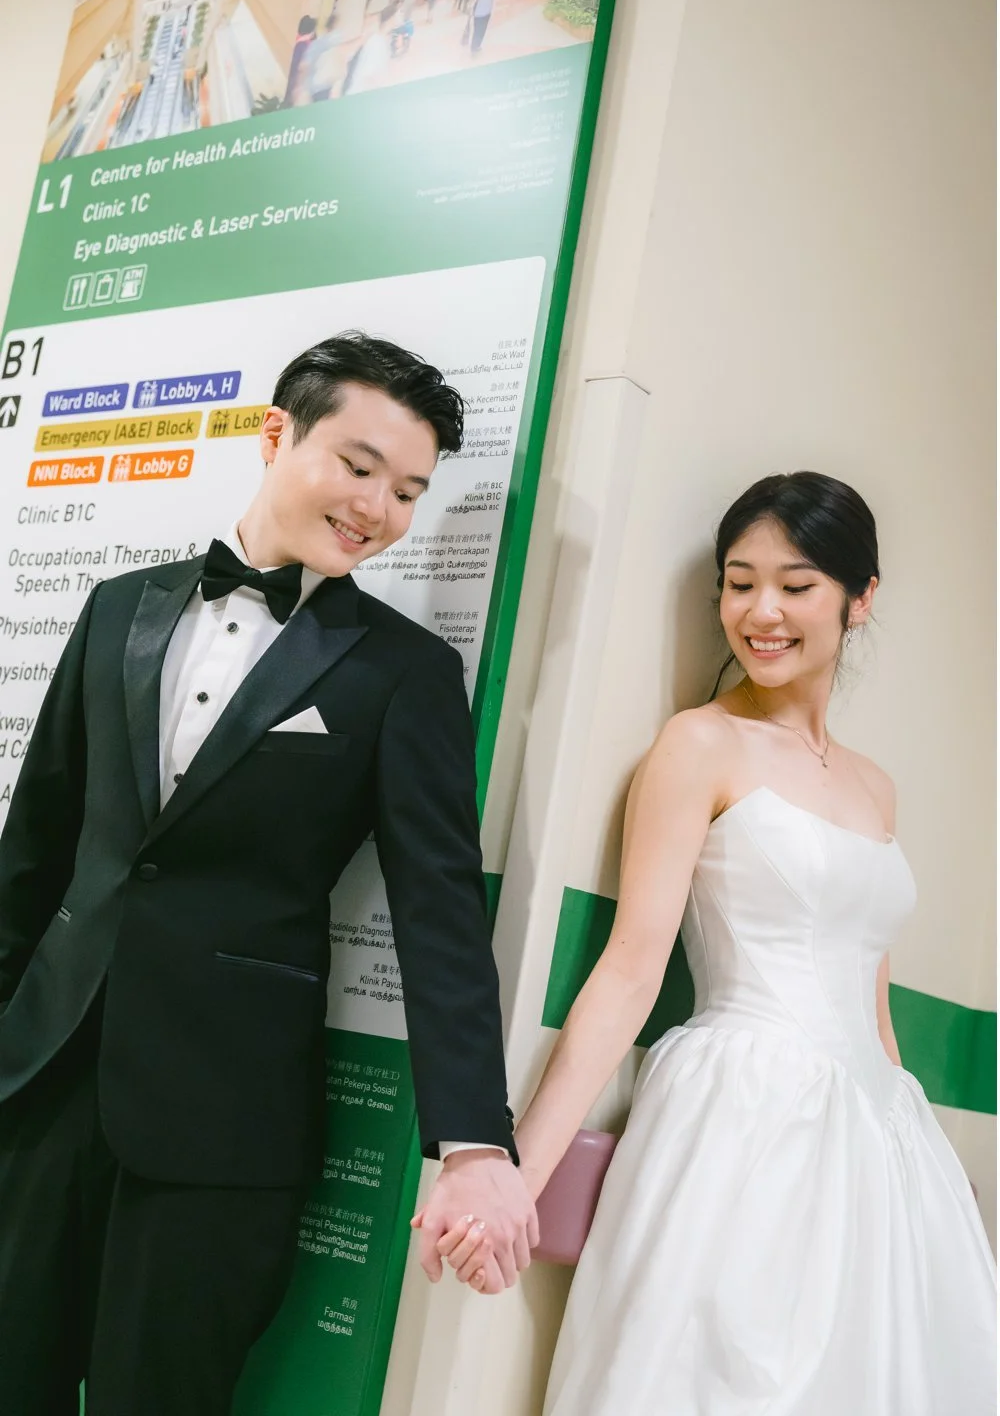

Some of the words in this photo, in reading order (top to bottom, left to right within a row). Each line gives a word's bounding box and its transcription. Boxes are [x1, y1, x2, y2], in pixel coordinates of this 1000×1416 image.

[91, 163, 142, 187] Centre
[145, 156, 170, 176] for
[171, 142, 227, 170] Health
[229, 126, 316, 158] Activation
[37, 174, 73, 214] L1
[83, 198, 126, 223] Clinic
[131, 192, 151, 215] 1C
[74, 239, 102, 262] Eye
[104, 222, 188, 255] Diagnostic
[191, 218, 205, 239] &
[208, 212, 260, 235] Laser
[261, 198, 340, 227] Services
[124, 269, 144, 281] ATM
[1, 336, 45, 380] B1
[160, 381, 202, 402] Lobby
[203, 380, 218, 398] A,
[221, 377, 235, 395] H
[50, 394, 83, 412] Ward
[84, 390, 121, 408] Block
[234, 412, 265, 430] Lob
[40, 429, 111, 449] Emergency
[114, 421, 153, 441] (A&E)
[157, 418, 195, 437] Block
[34, 464, 58, 482] NNI
[60, 461, 97, 481] Block
[134, 457, 176, 477] Lobby
[177, 454, 189, 472] G
[464, 492, 485, 502] Klinik
[486, 491, 502, 501] B1C
[18, 504, 60, 525] Clinic
[64, 503, 96, 523] B1C
[9, 546, 109, 571] Occupational
[114, 545, 182, 566] Therapy
[185, 542, 198, 561] &
[424, 547, 447, 558] Terapi
[447, 546, 490, 557] Percakapan
[14, 572, 71, 598] Speech
[0, 616, 76, 640] Physiother
[439, 623, 477, 635] Fisioterapi
[359, 974, 381, 986] Klinik
[343, 1077, 371, 1093] Pekerja
[353, 1160, 383, 1176] Dietetik
[324, 1219, 352, 1234] Pesakit
[352, 1227, 371, 1240] Luar
[324, 1306, 356, 1324] Farmasi
